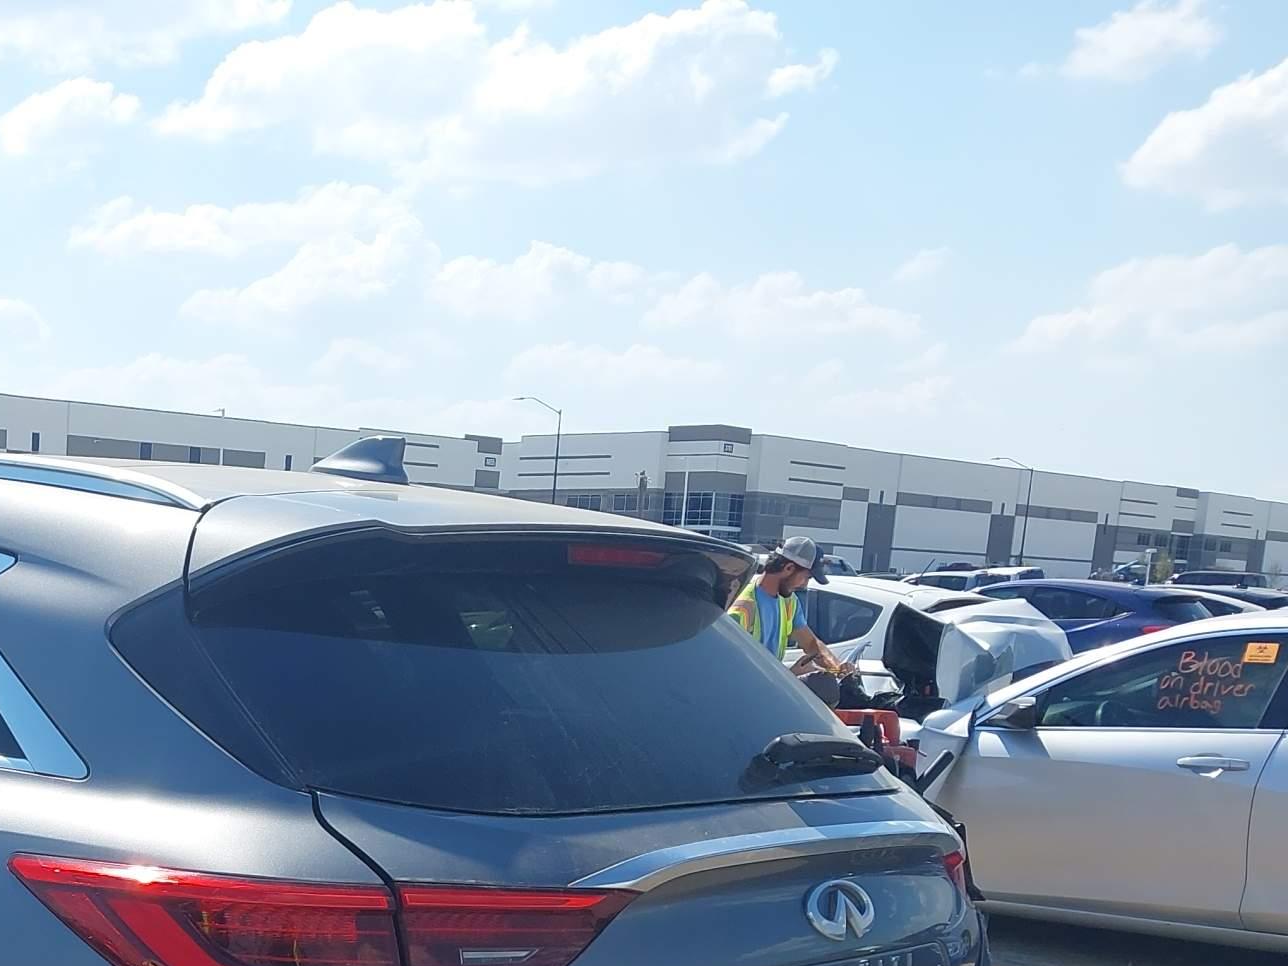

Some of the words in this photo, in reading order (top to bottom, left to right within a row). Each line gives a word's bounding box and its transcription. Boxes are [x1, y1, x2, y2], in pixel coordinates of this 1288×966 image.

[1179, 651, 1243, 678] Blood
[1160, 674, 1183, 689] on
[1190, 676, 1255, 697] driver
[1158, 694, 1222, 714] airbag
